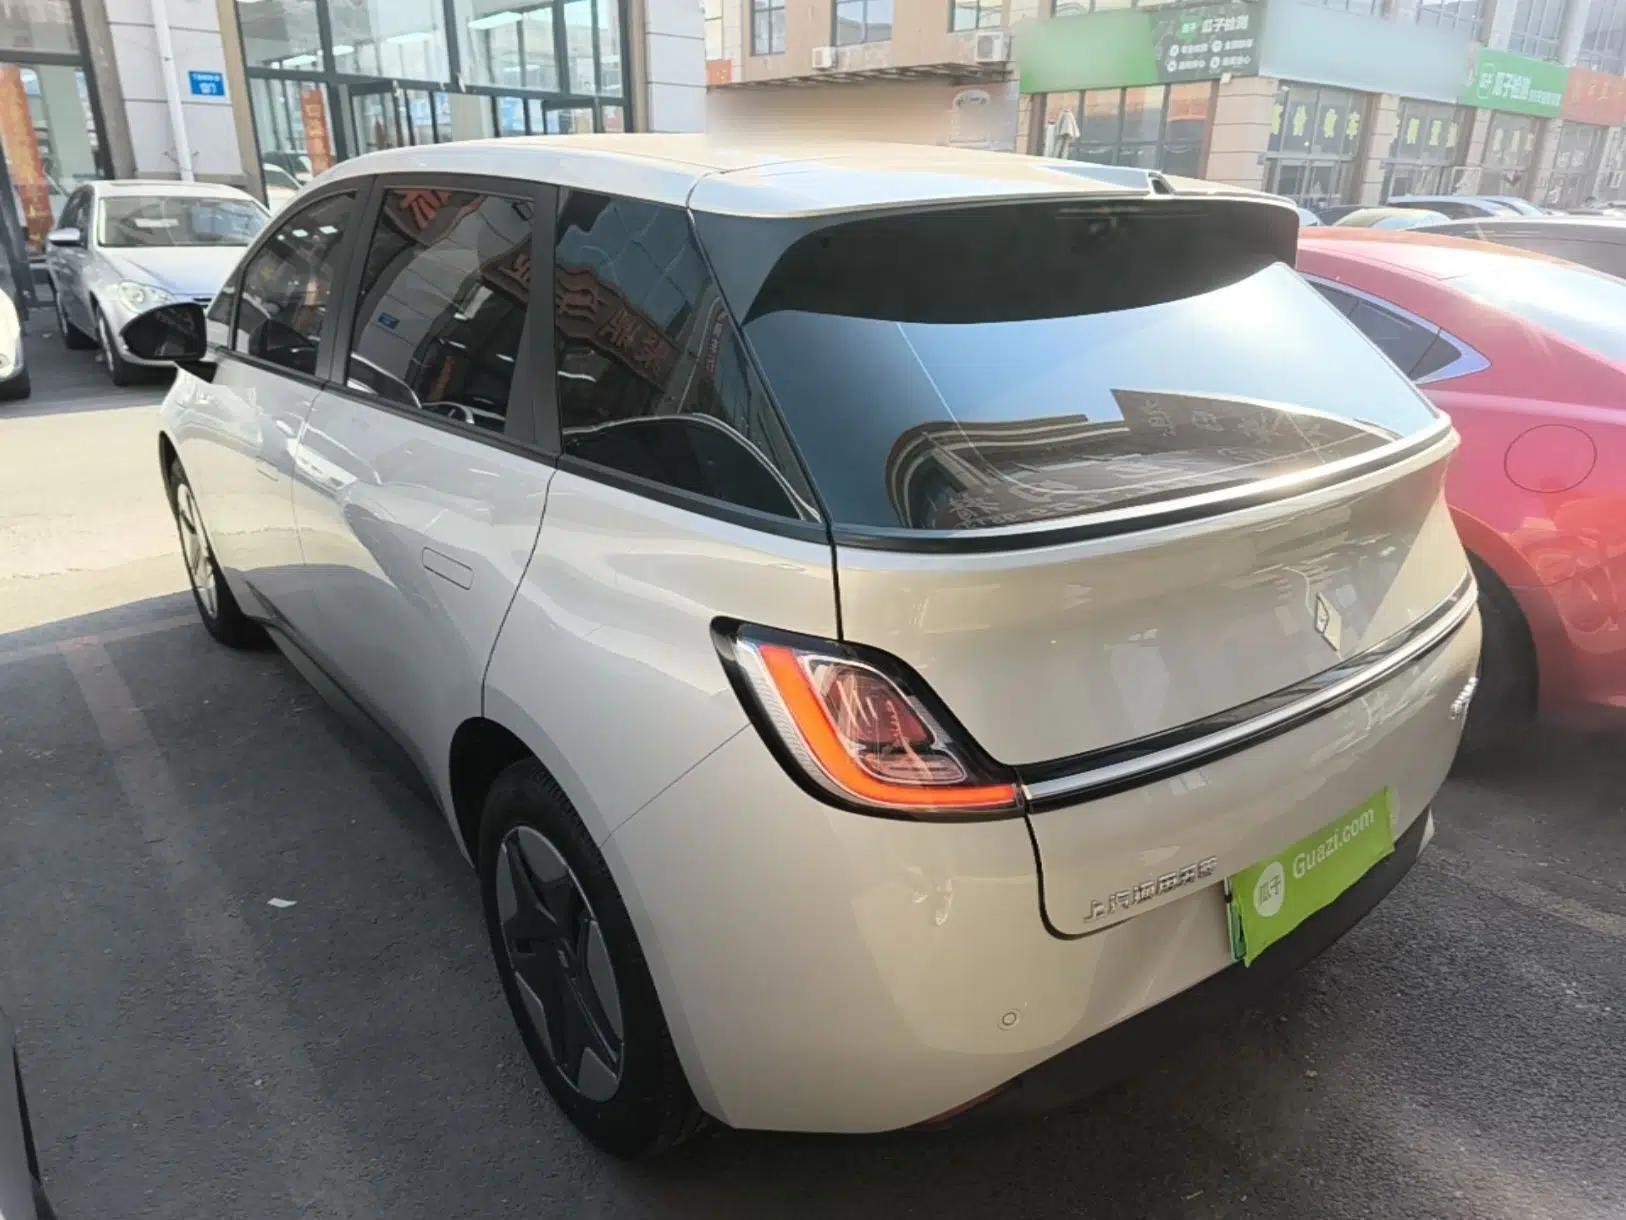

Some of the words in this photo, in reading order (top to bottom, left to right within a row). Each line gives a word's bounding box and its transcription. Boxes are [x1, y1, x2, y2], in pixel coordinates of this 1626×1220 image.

[1293, 808, 1375, 878] Guazi.com
[1083, 855, 1218, 922] 上汽通用五菱
